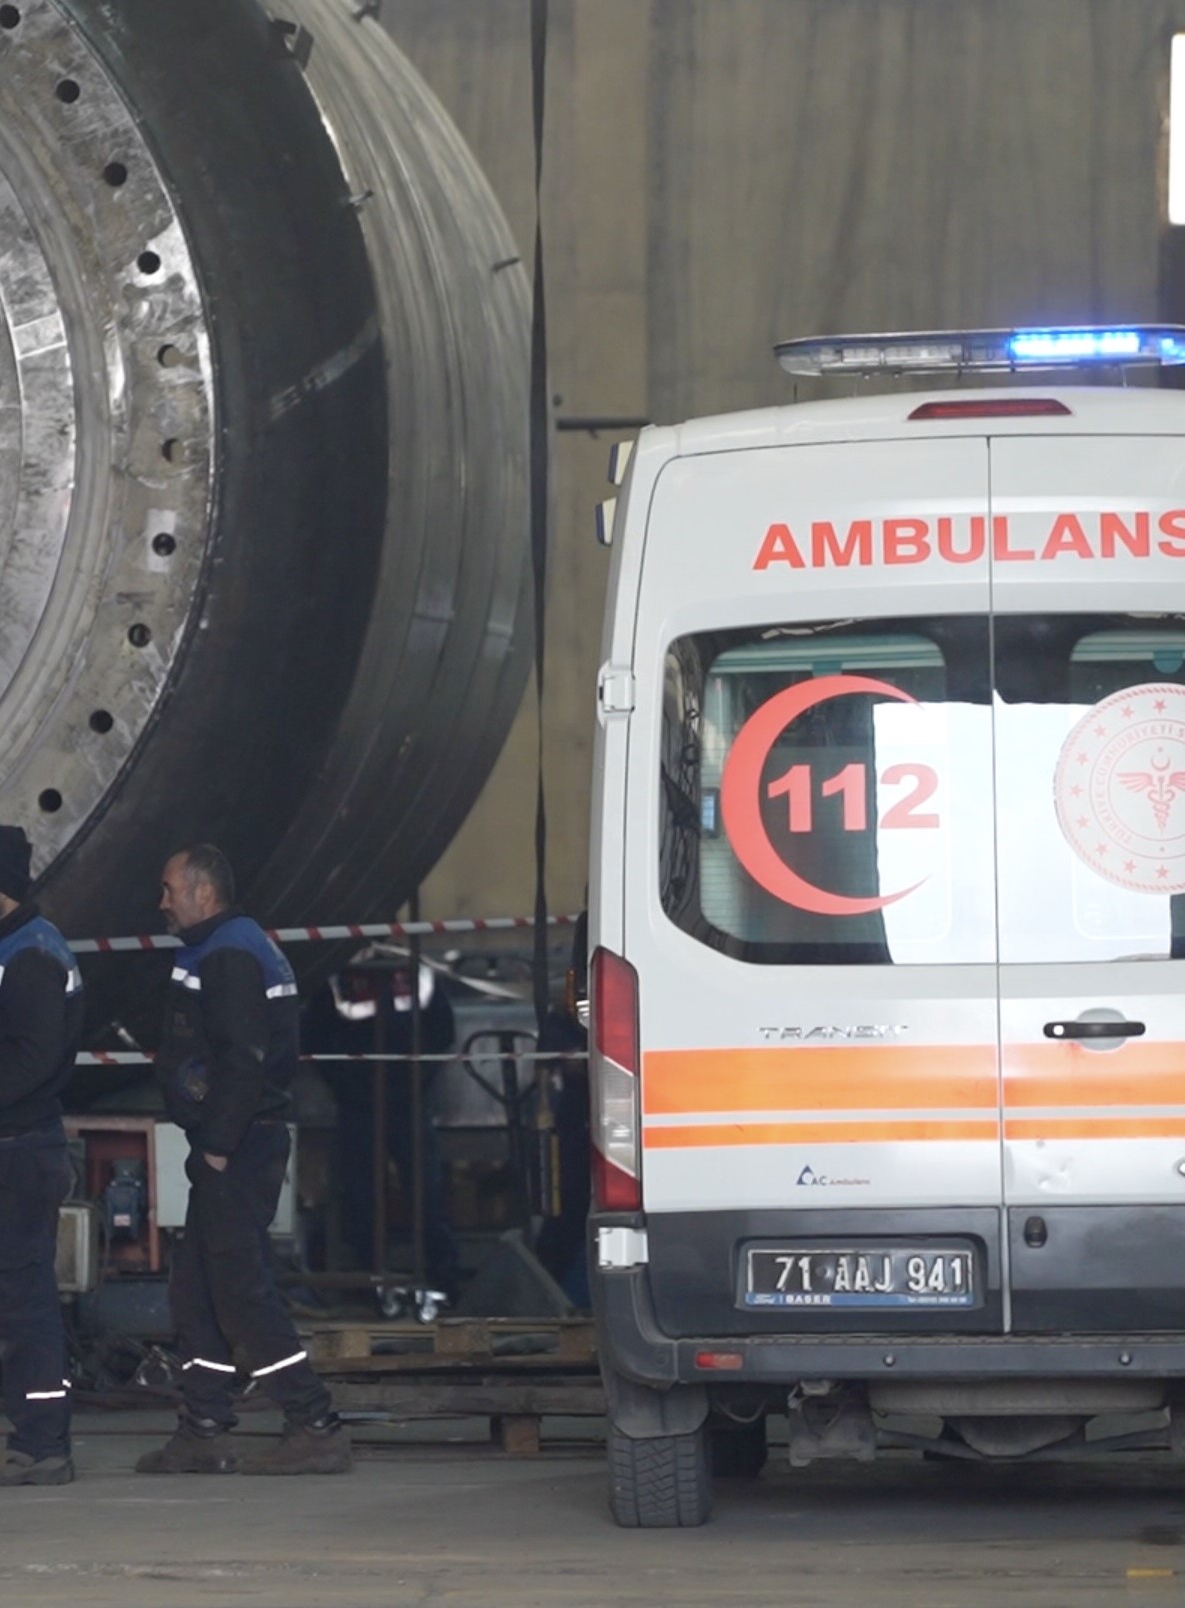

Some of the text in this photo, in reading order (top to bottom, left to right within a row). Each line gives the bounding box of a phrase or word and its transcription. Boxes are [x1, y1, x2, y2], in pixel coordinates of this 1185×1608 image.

[752, 509, 1185, 571] AMBULANS
[767, 762, 940, 833] 112
[758, 1024, 909, 1040] TRANSIT
[774, 1256, 962, 1291] 71 AAJ 941
